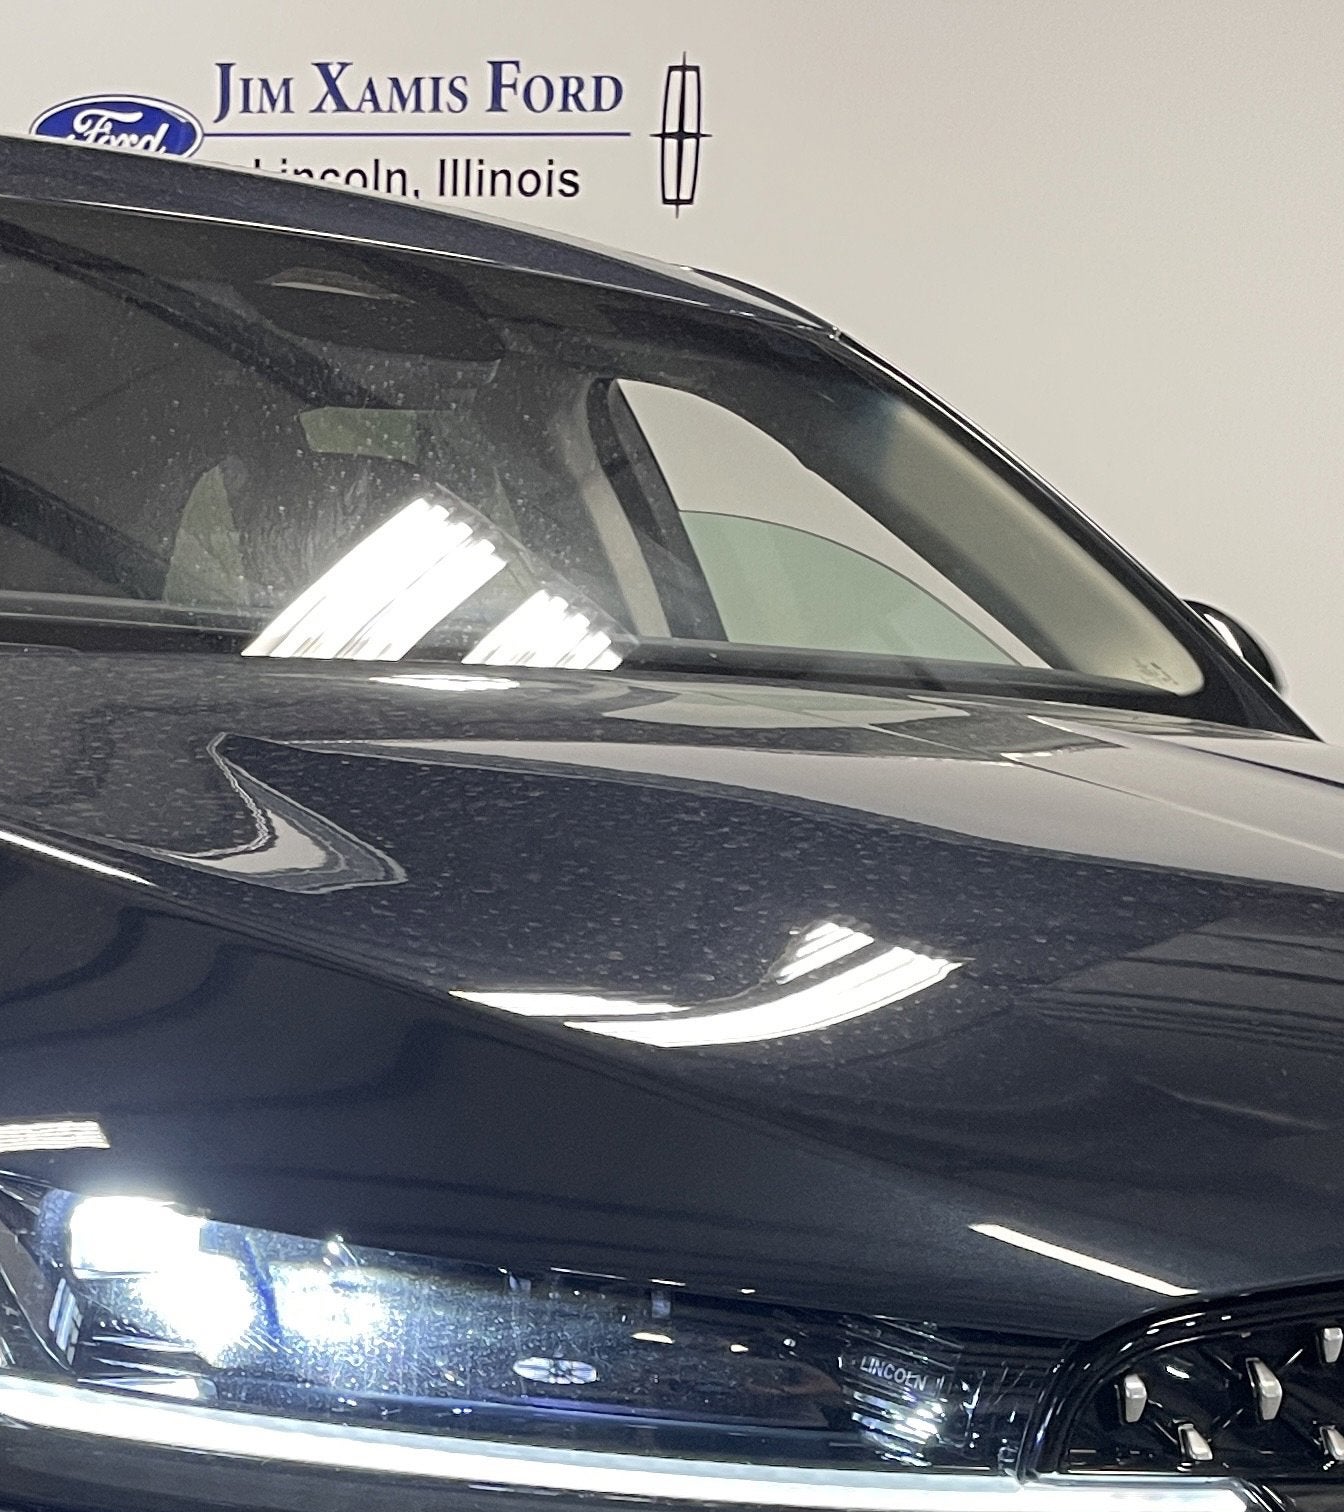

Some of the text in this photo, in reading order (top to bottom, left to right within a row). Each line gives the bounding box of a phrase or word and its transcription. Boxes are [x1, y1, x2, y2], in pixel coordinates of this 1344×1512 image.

[213, 60, 624, 123] JIM XAMIS FORD
[438, 158, 581, 198] Illinois
[859, 1356, 928, 1392] LINCOLN
